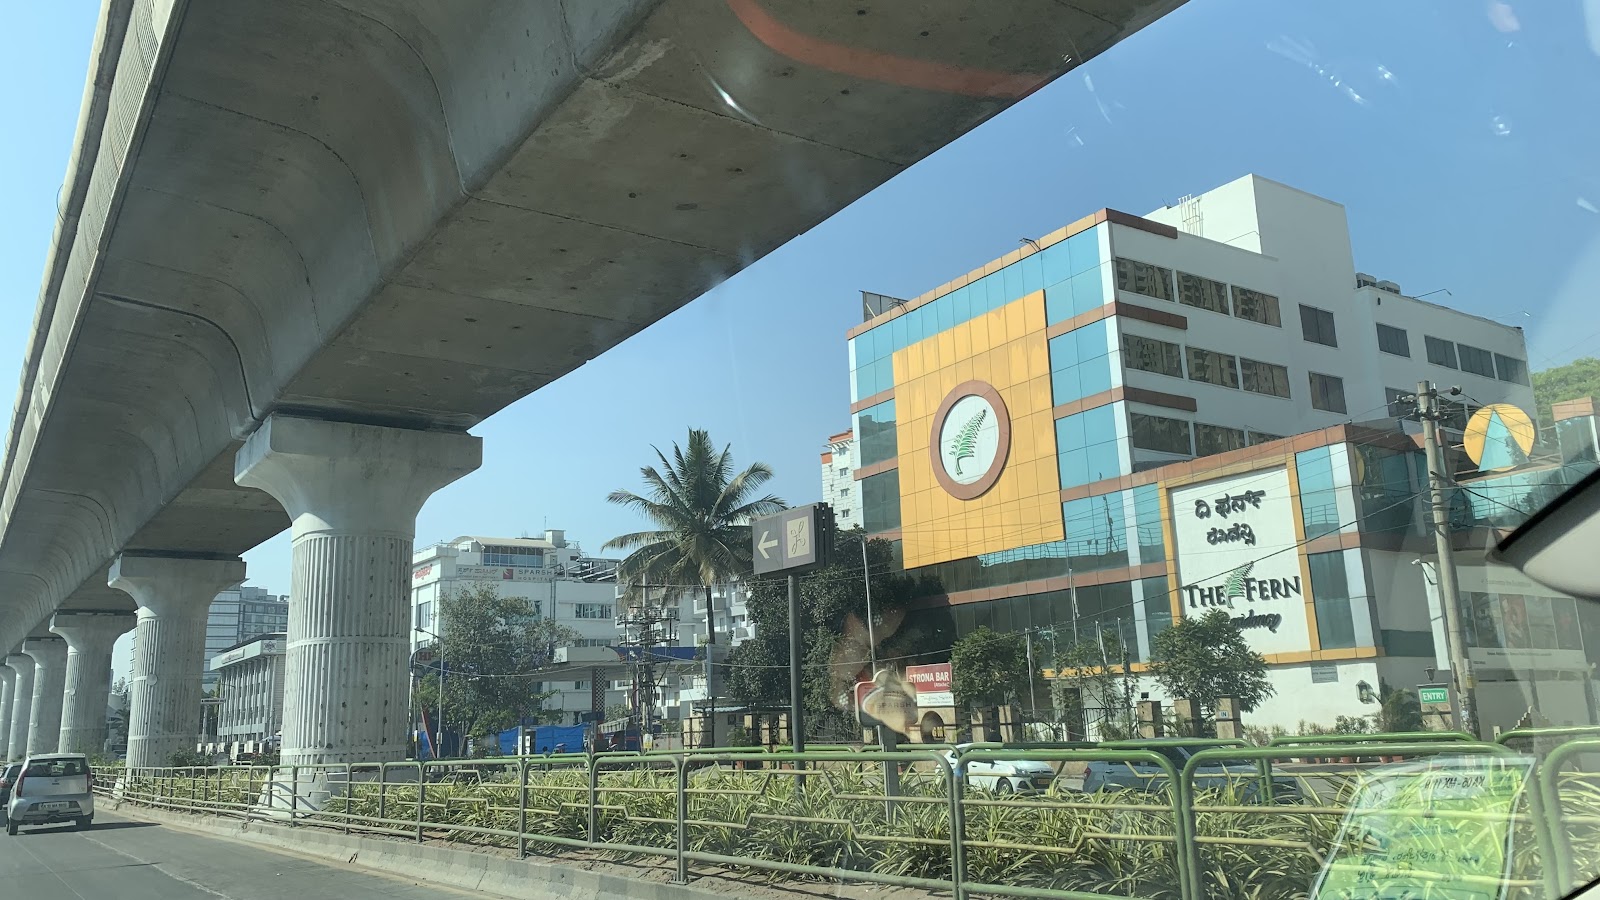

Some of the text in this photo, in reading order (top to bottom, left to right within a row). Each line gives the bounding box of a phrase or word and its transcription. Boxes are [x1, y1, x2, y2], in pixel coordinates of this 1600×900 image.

[1183, 576, 1301, 608] THE FERN
[935, 671, 950, 682] BAR
[1422, 691, 1445, 701] ENTRY
